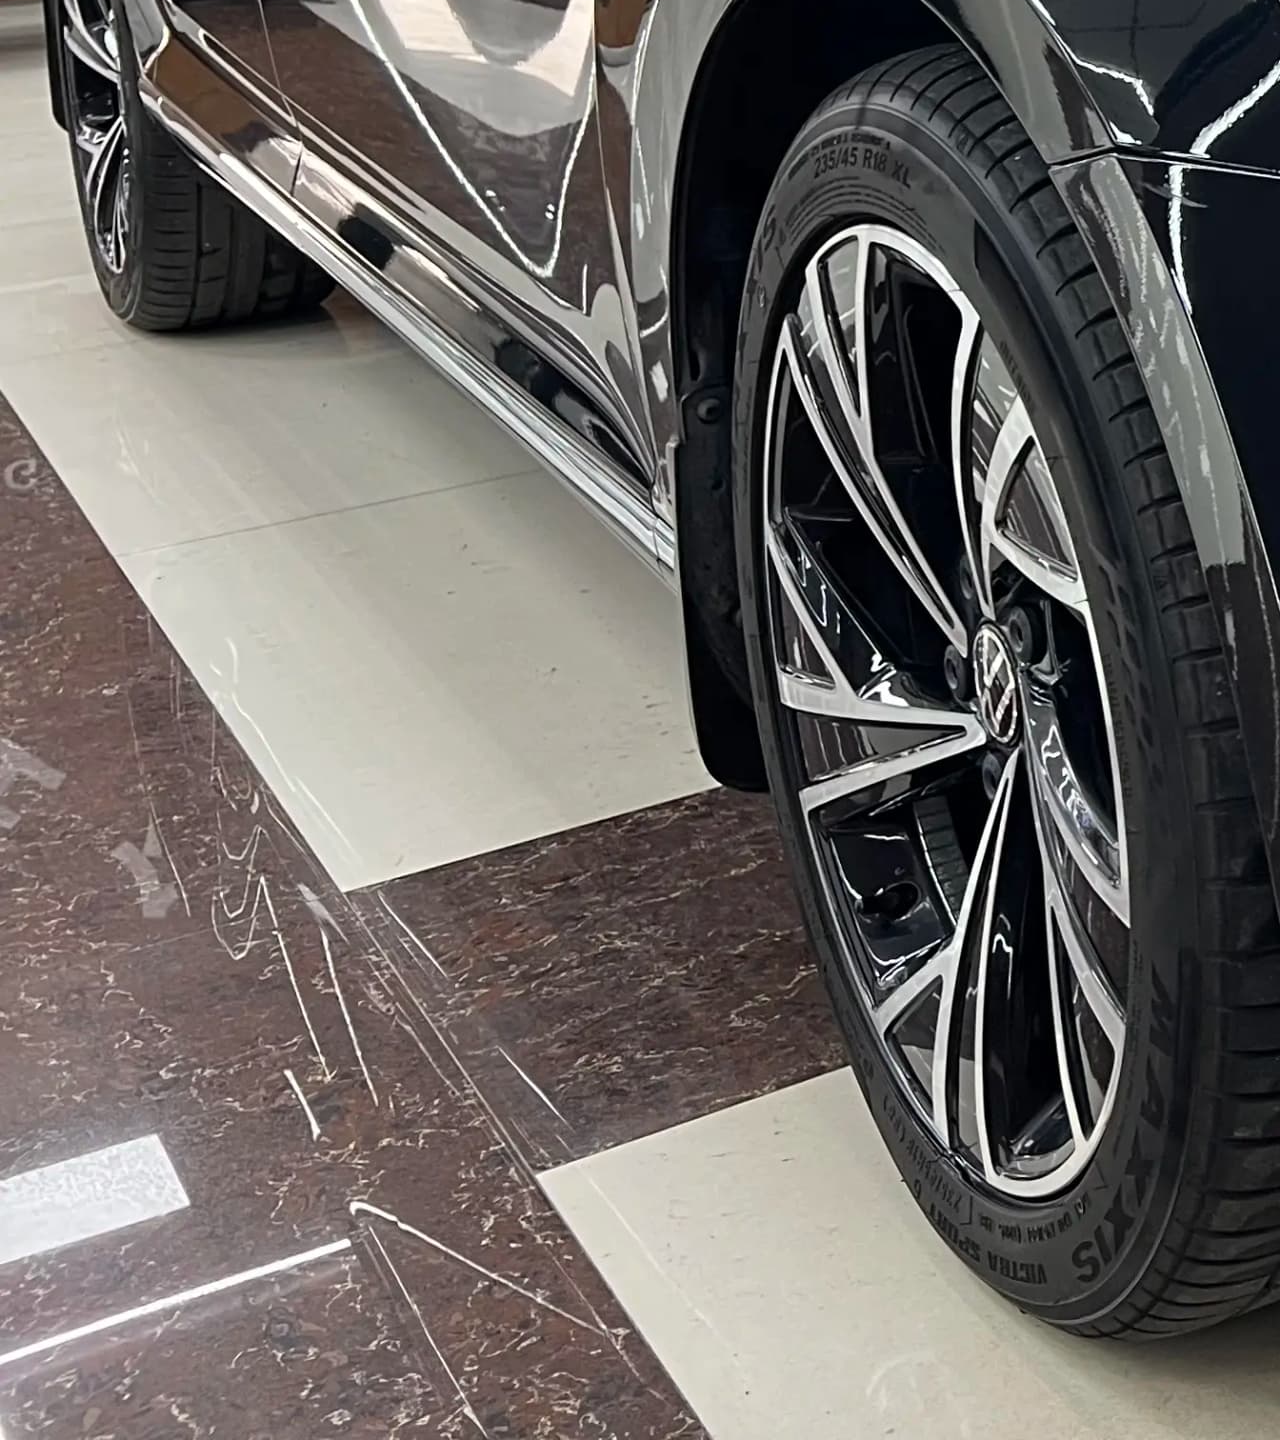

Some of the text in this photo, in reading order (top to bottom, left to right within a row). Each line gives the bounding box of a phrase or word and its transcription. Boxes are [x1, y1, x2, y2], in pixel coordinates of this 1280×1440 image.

[814, 146, 912, 189] 235/45 R18 XL
